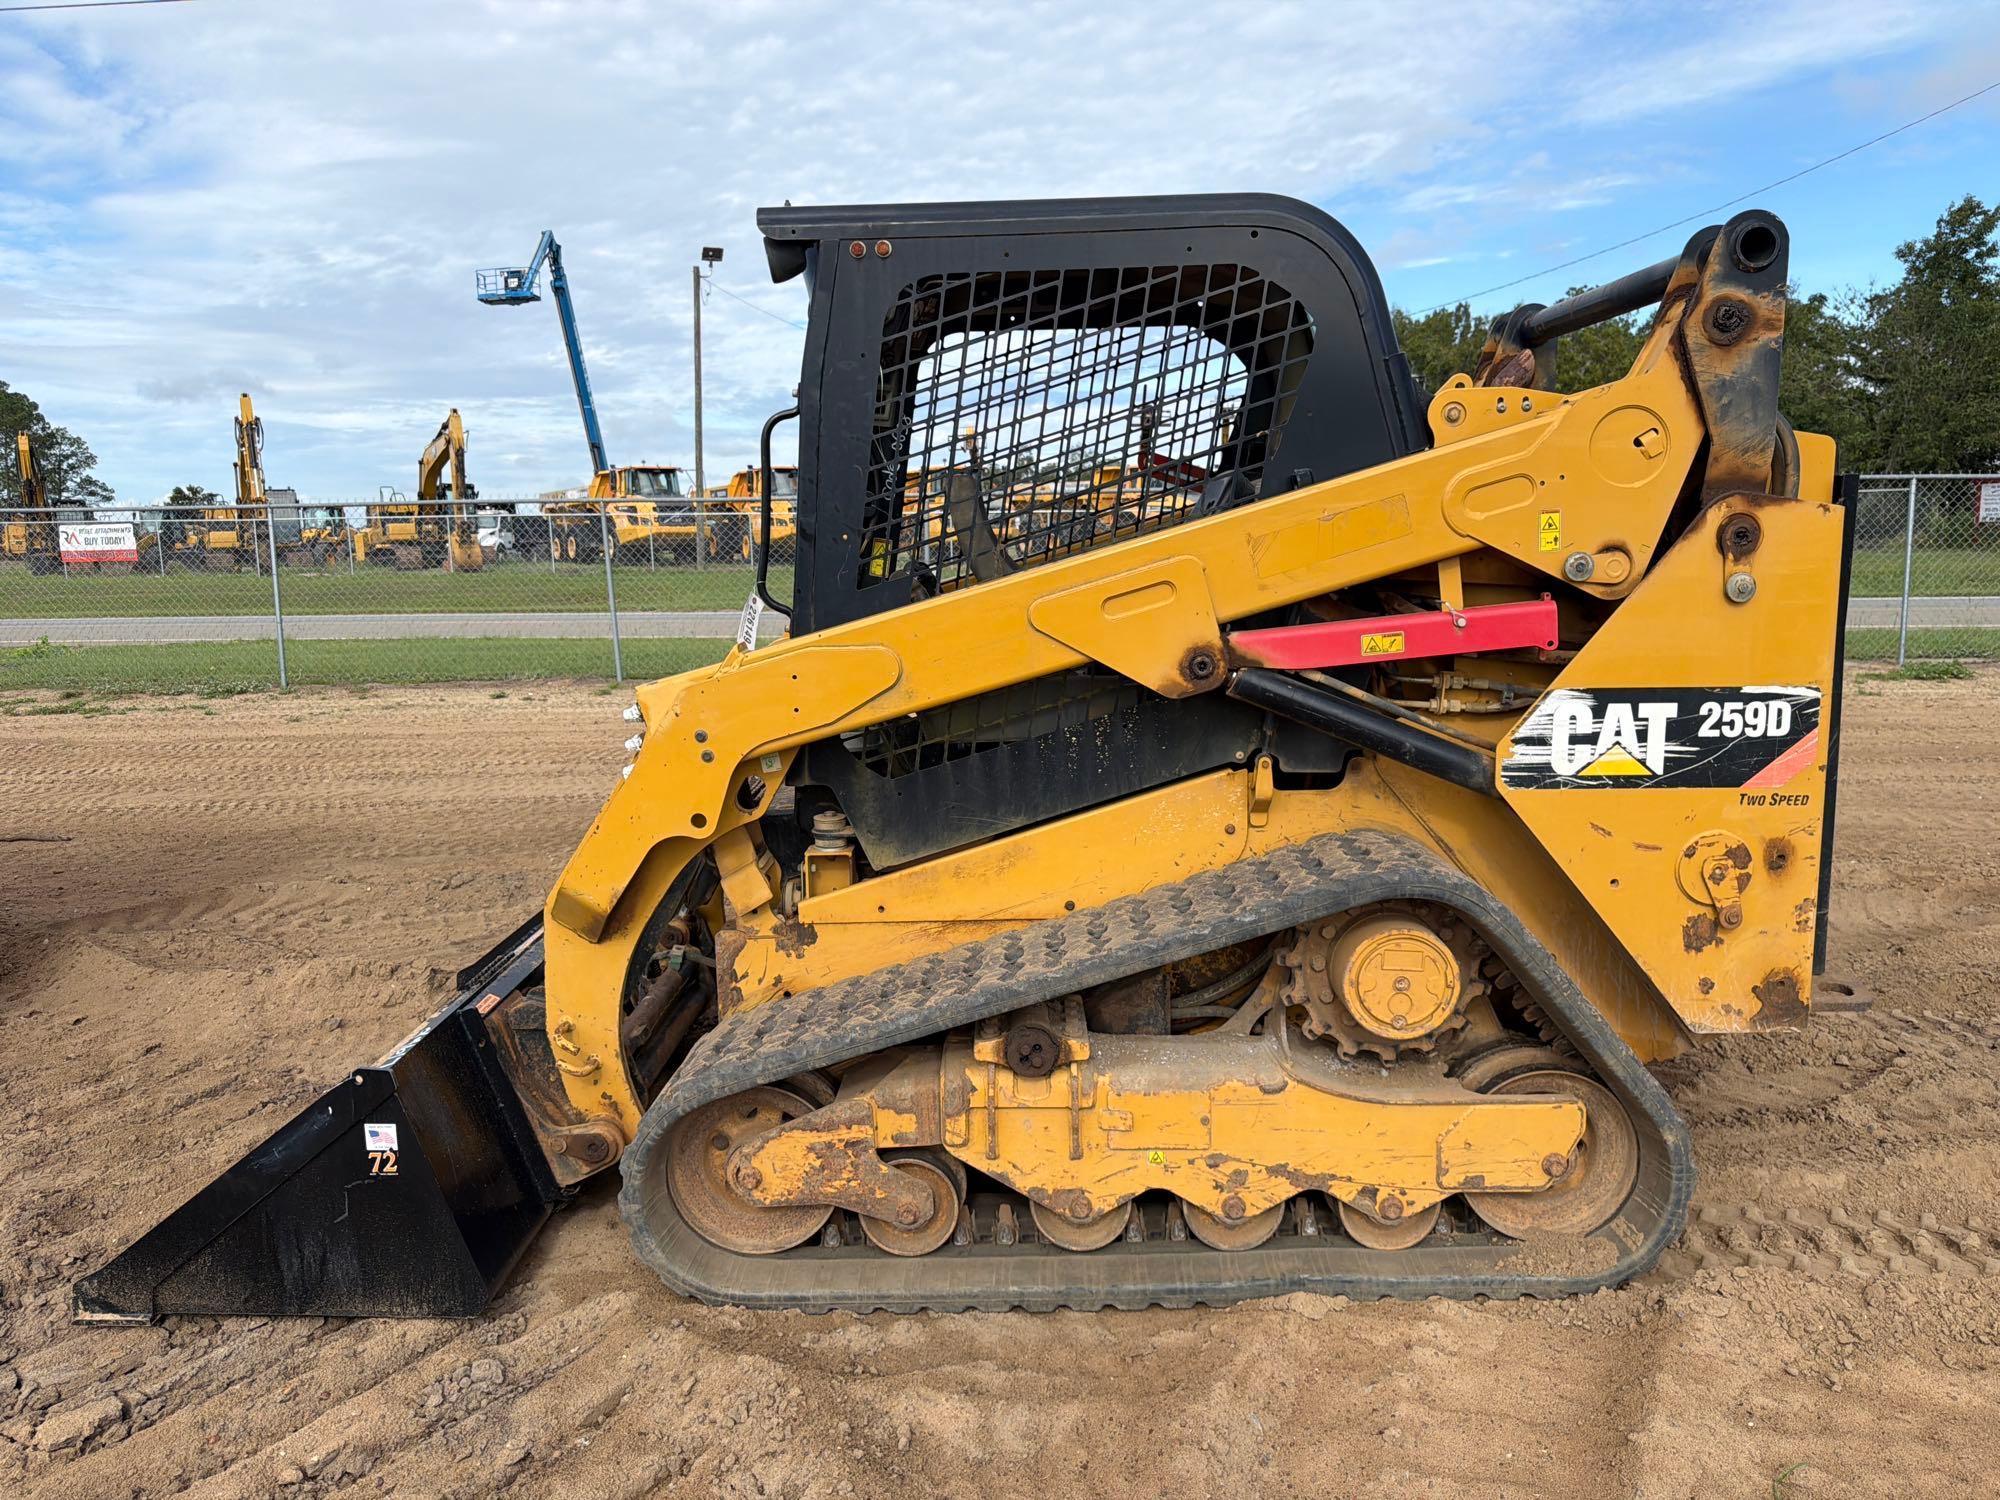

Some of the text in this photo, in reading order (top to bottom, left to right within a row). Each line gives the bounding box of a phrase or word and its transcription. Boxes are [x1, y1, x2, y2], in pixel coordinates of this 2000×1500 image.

[84, 536, 126, 546] BUY TODAY!
[743, 604, 757, 645] 226149
[1551, 702, 1678, 776] CAT
[1698, 701, 1792, 739] 259D
[368, 1151, 398, 1173] 72
